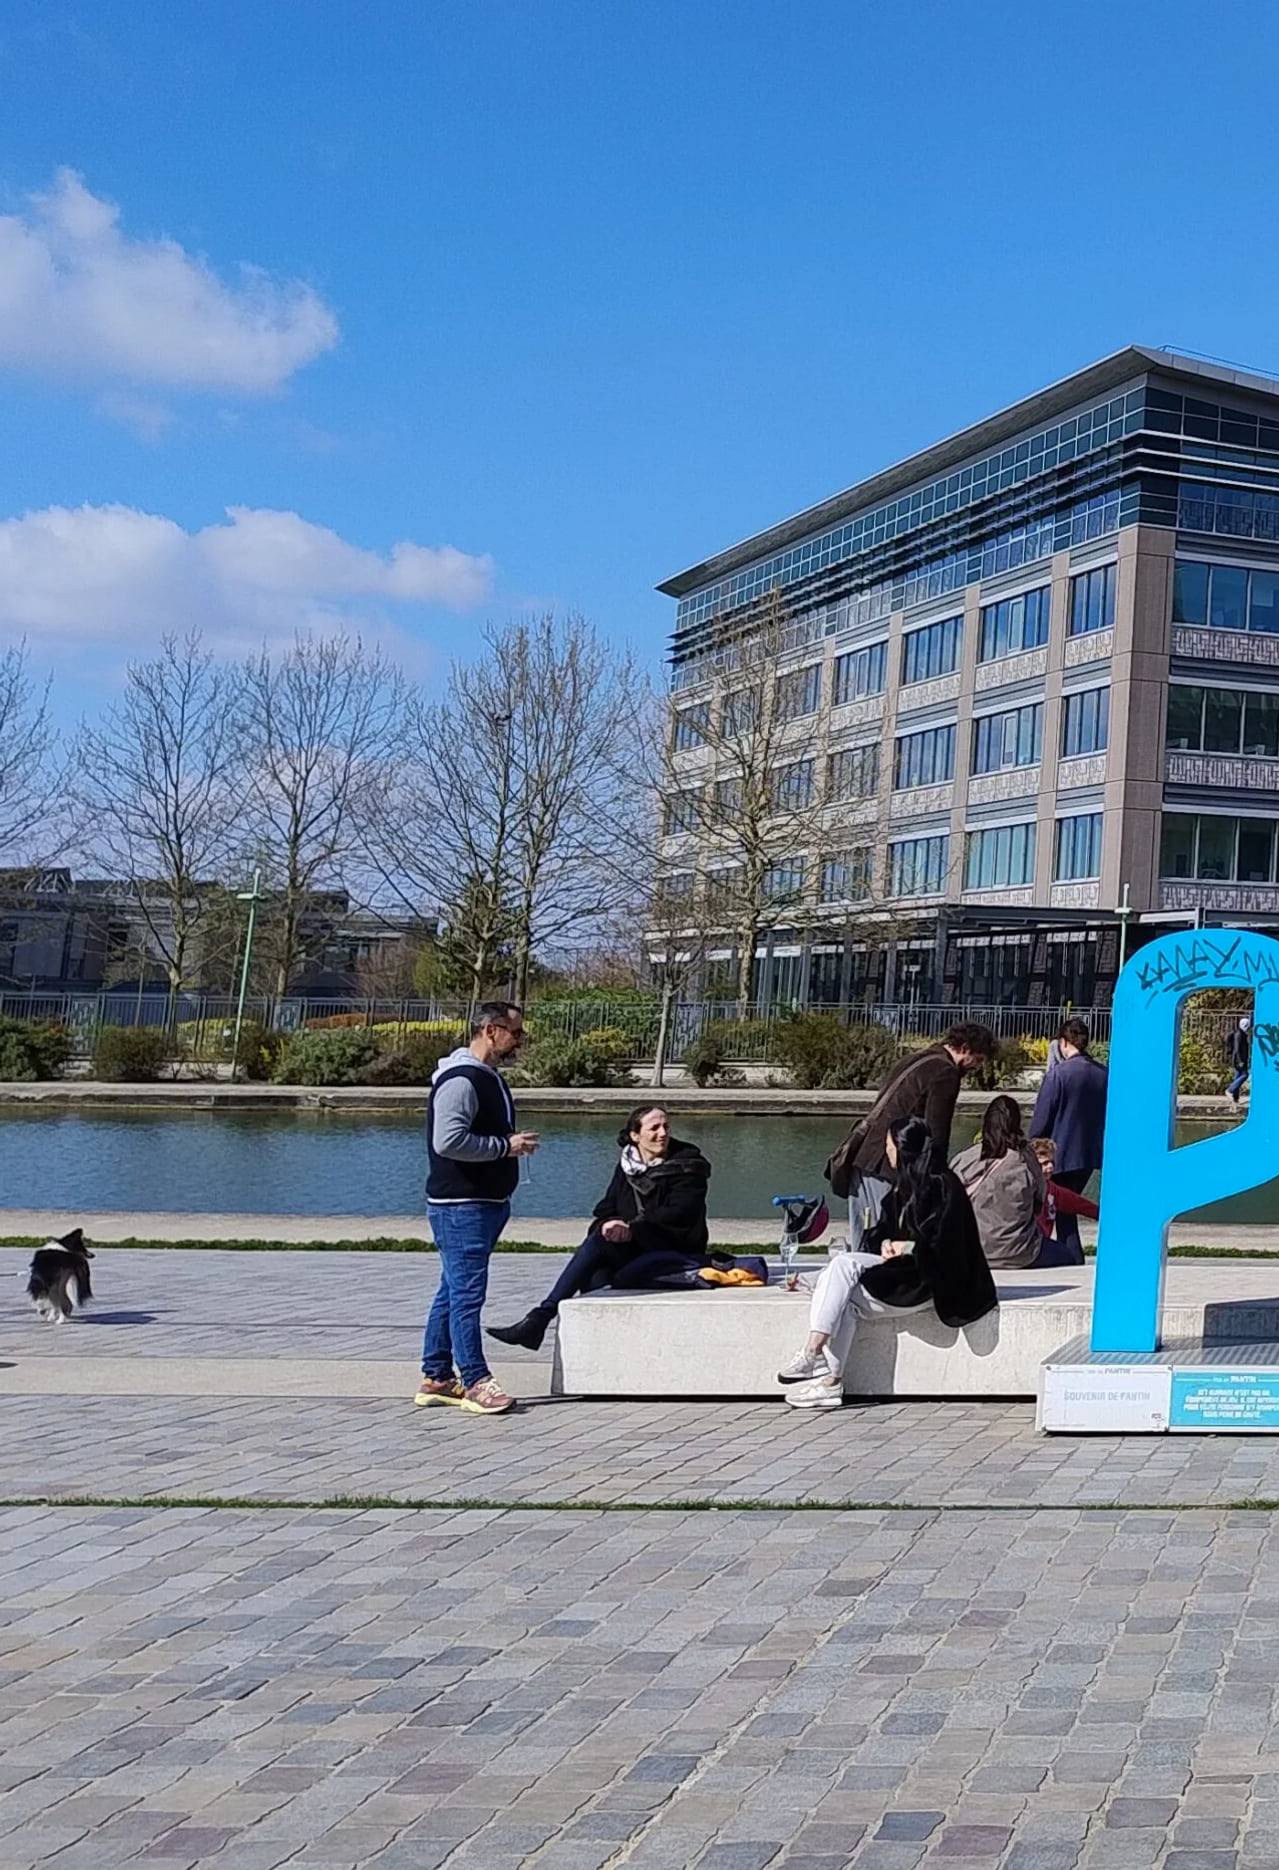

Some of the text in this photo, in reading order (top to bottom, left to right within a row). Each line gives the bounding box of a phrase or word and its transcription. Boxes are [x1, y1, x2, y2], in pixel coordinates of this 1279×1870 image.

[1064, 1391, 1151, 1400] SOUVENIR DE PANTIN
